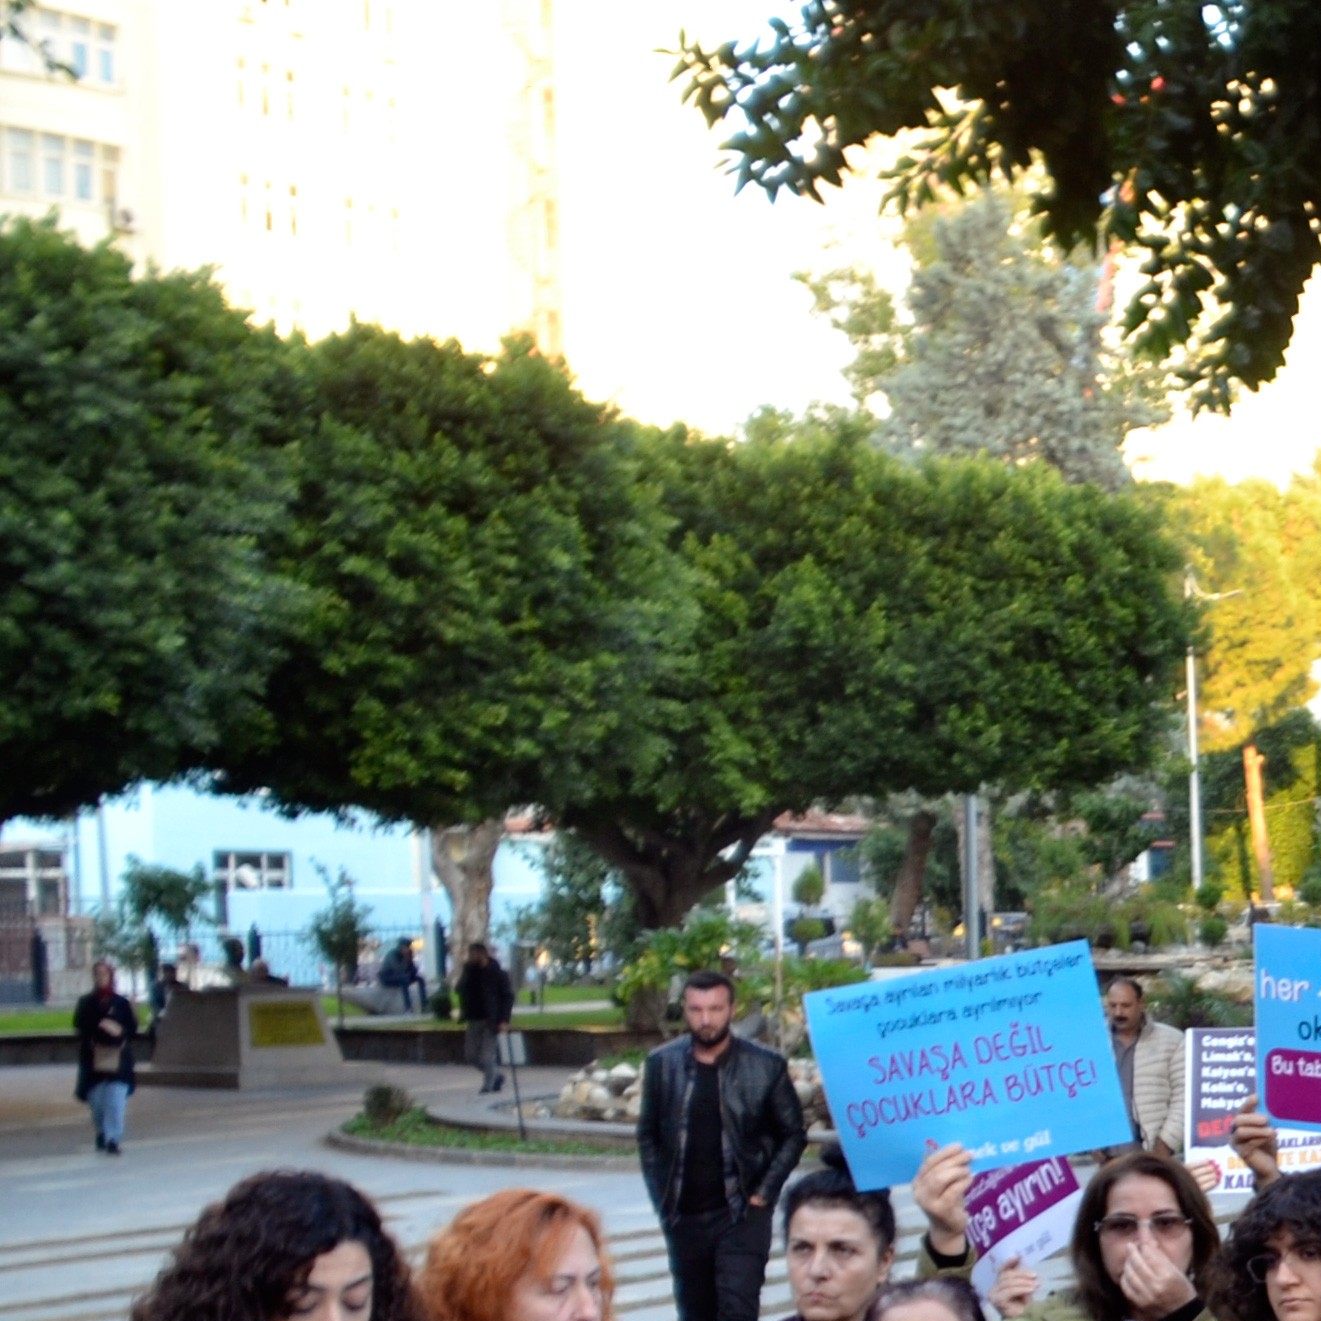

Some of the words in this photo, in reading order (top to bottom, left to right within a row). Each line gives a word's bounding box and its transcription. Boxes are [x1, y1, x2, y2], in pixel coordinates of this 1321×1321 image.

[825, 991, 880, 1015] Savaşa
[884, 980, 938, 1006] ayrılan
[1260, 968, 1309, 1002] her
[876, 1007, 957, 1039] çocuklara
[867, 1042, 968, 1085] SAVAŞA
[974, 1022, 1053, 1064] DEĞİL
[1271, 1055, 1293, 1076] Bu
[845, 1077, 998, 1138] ÇOCUKLARA
[1004, 1058, 1097, 1102] BÜTÇE!
[997, 1156, 1066, 1224] ayırın!
